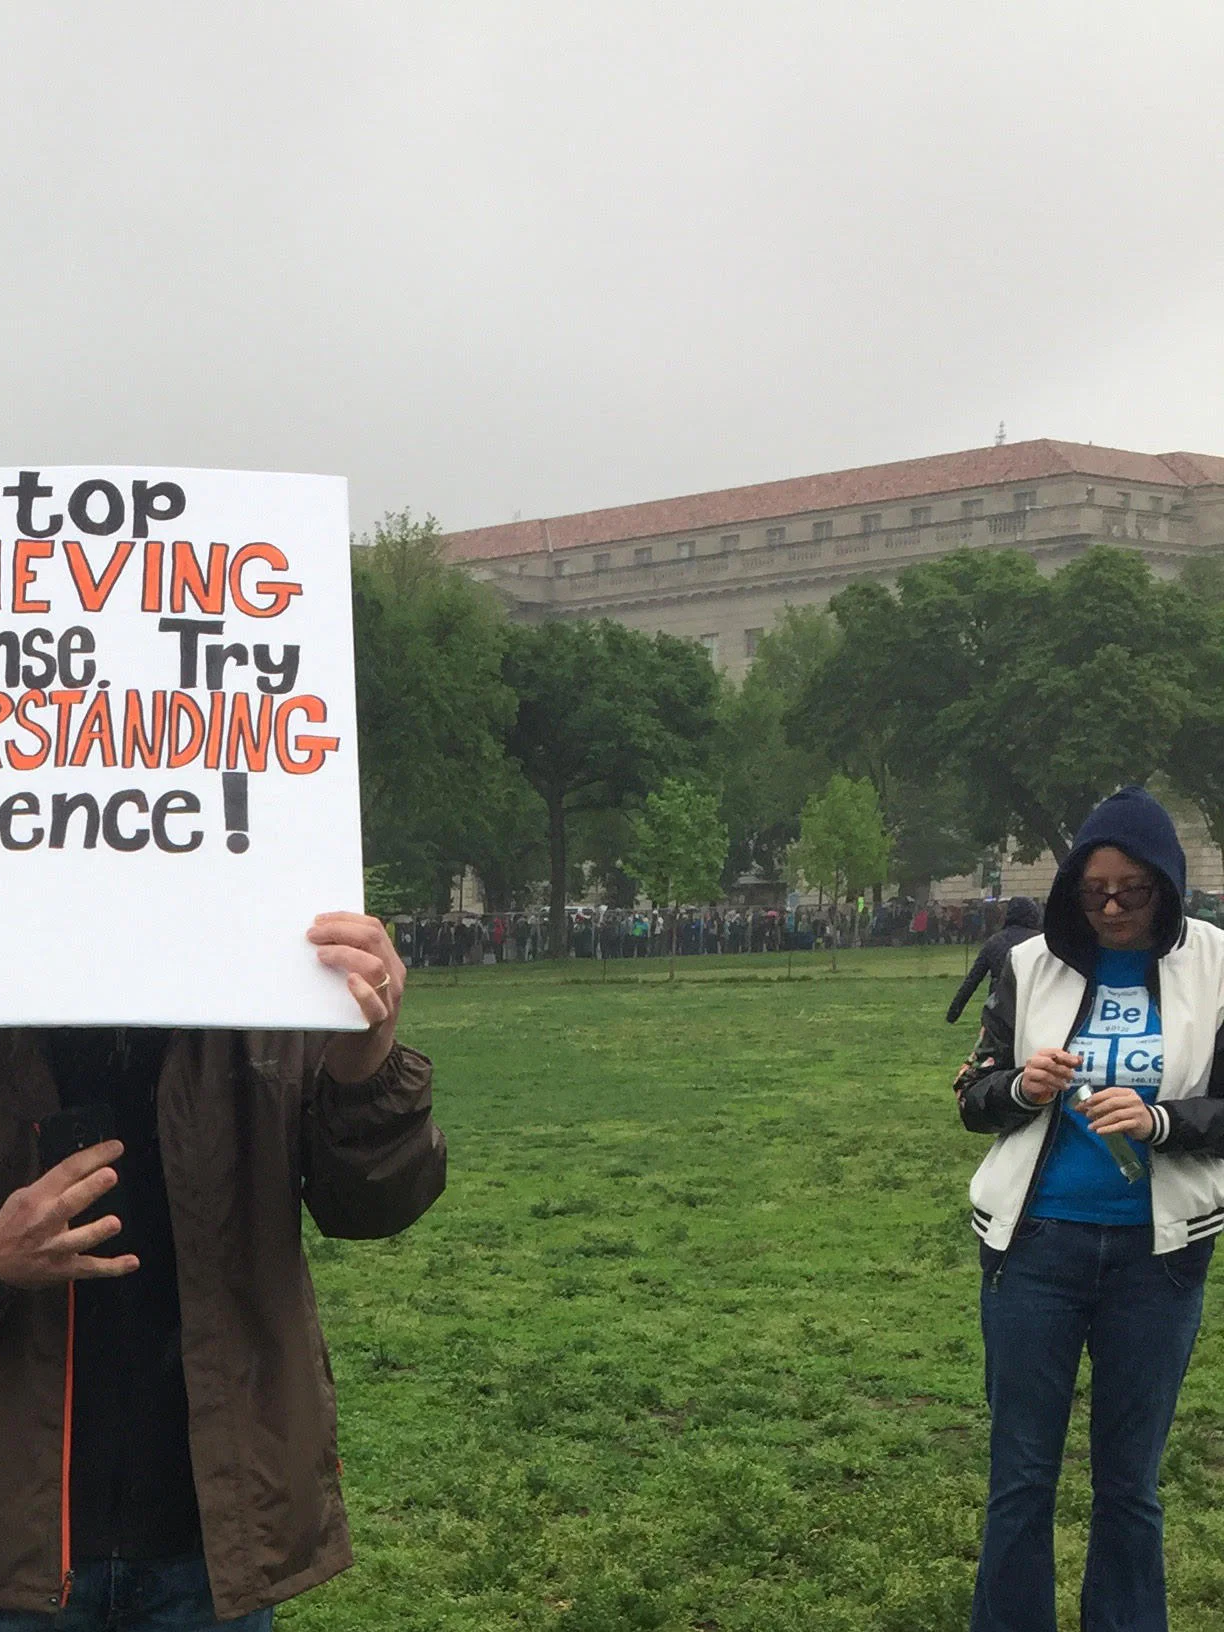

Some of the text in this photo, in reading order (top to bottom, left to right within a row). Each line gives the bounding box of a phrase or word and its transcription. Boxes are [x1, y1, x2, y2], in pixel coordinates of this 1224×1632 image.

[159, 618, 301, 694] Try
[1100, 999, 1141, 1023] Be
[1124, 1049, 1163, 1073] Ce
